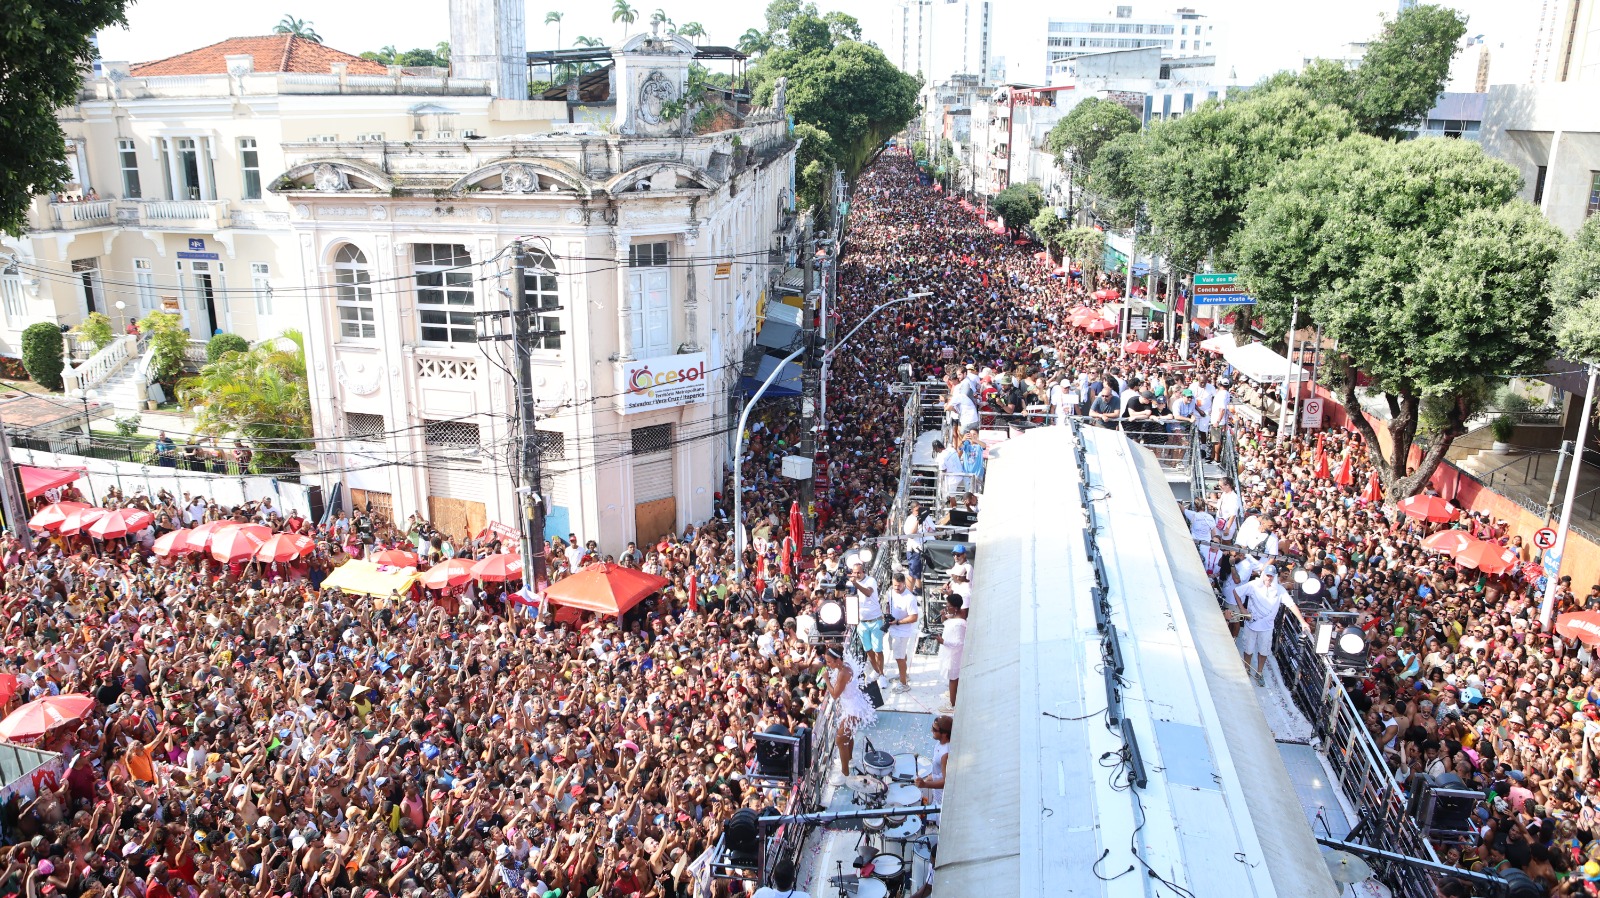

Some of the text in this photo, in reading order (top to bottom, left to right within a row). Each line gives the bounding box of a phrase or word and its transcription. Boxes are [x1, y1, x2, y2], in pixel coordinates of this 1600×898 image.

[654, 361, 704, 385] cesol
[1539, 533, 1550, 545] E
[1567, 619, 1600, 637] BRAHM
